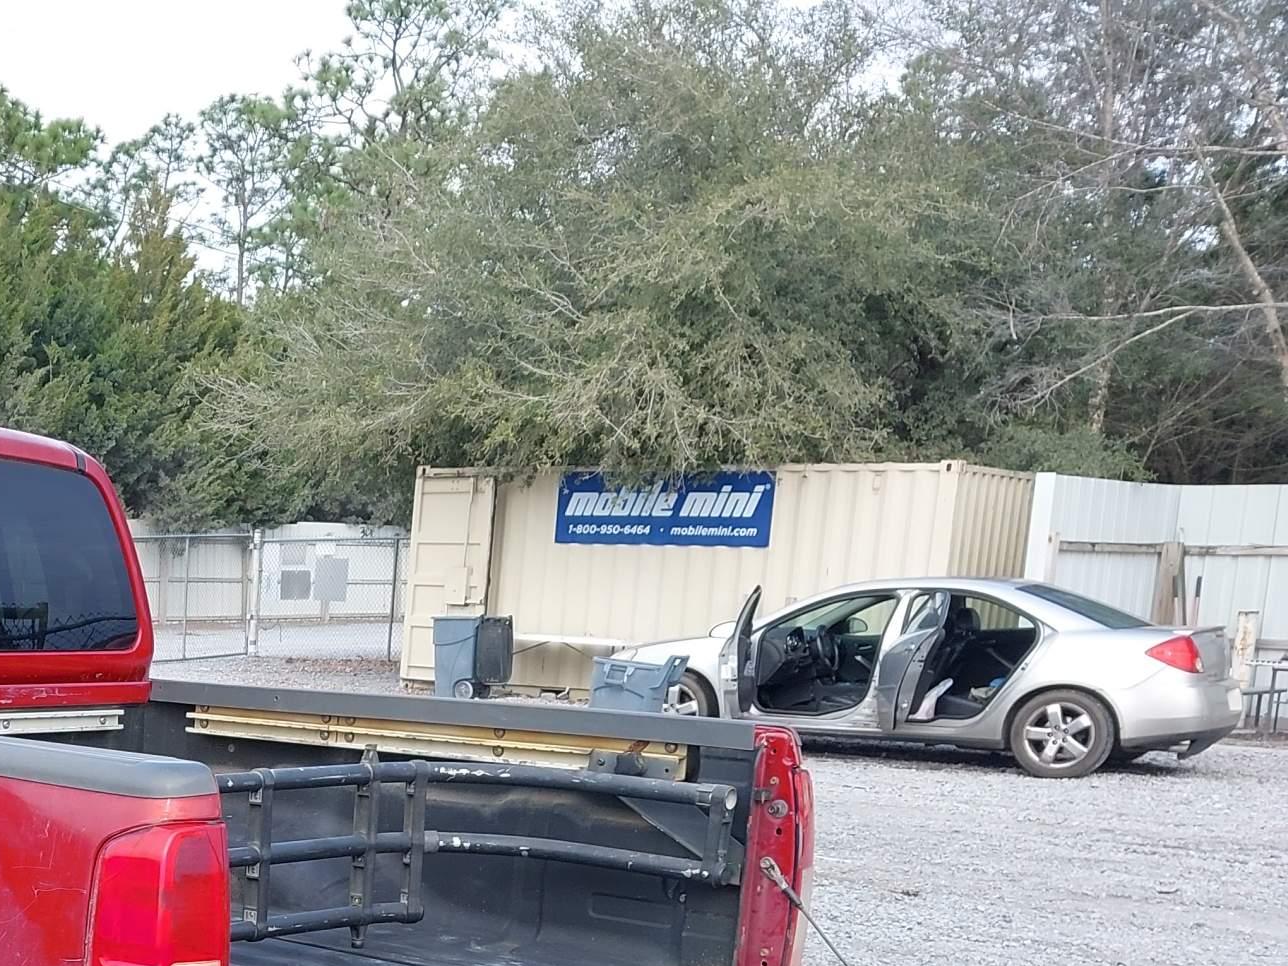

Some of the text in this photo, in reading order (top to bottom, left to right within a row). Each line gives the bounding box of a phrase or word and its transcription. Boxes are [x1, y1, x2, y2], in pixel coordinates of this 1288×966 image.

[565, 479, 765, 518] mobile mini
[568, 524, 757, 537] 1-800-950-6464 mobilemini.com
